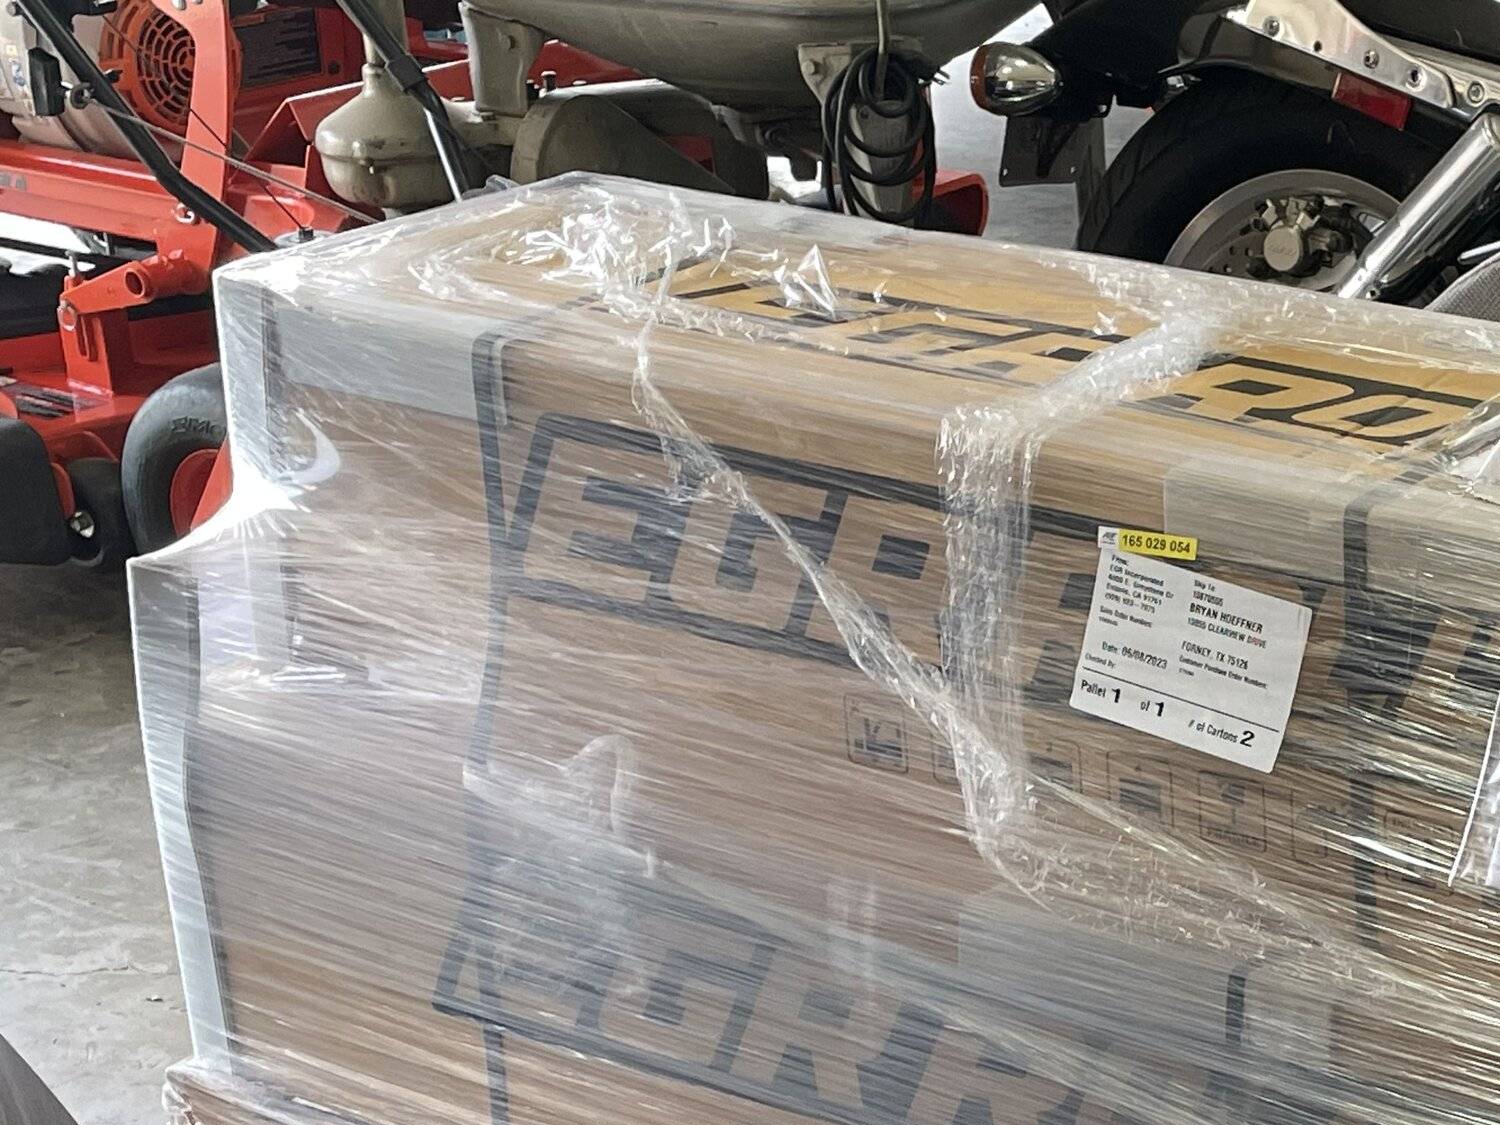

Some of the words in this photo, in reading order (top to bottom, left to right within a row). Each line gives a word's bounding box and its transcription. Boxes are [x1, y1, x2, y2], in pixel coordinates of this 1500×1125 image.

[1122, 534, 1143, 548] 165
[1145, 537, 1167, 551] 029
[1169, 540, 1191, 554] 054
[1189, 602, 1218, 620] BRYAN
[1220, 611, 1264, 635] HOEFFNER
[1216, 651, 1226, 663] TX
[1081, 679, 1106, 698] Pallet
[1111, 688, 1121, 703] 1
[1140, 700, 1151, 712] of
[1155, 701, 1165, 717] 1
[1206, 724, 1239, 743] Cartons
[1239, 730, 1255, 748] 2
